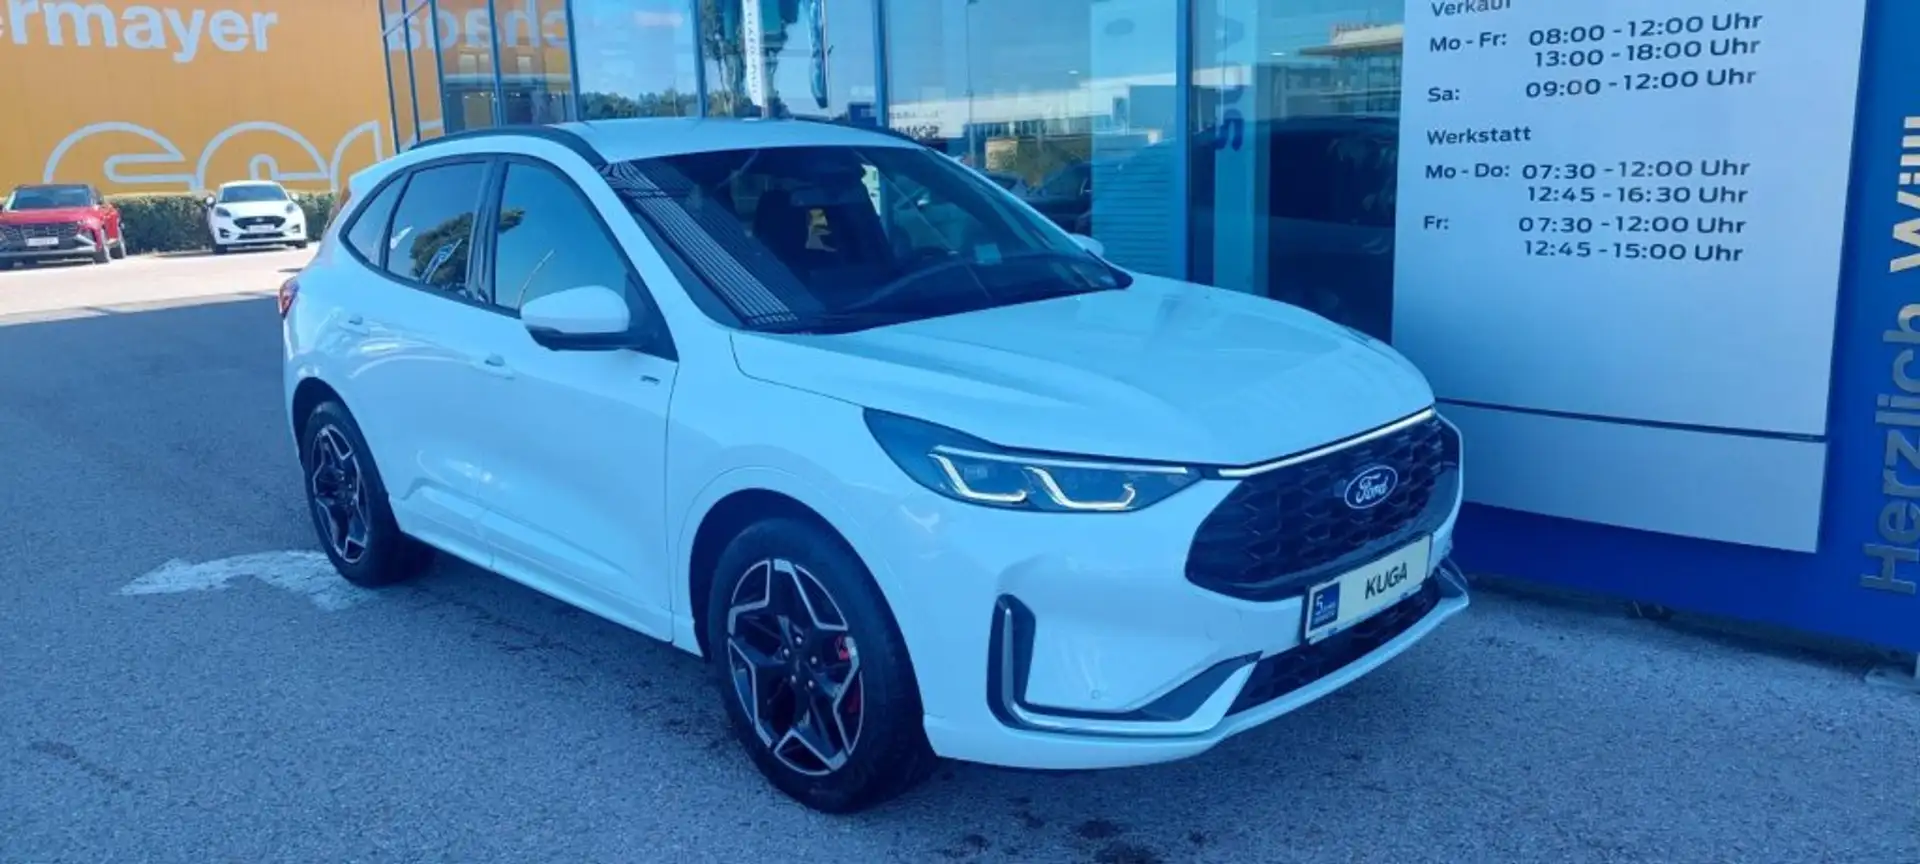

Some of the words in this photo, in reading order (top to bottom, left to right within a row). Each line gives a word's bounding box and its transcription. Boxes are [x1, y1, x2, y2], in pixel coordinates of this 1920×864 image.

[0, 0, 278, 63] rmayer
[1430, 36, 1461, 52] Mo
[1479, 31, 1507, 47] Fr:
[1529, 24, 1605, 46] 08:00
[1628, 16, 1704, 37] 12:00
[1712, 12, 1763, 31] Uhr
[1535, 49, 1604, 67] 13:00
[1626, 40, 1702, 61] 18:00
[1710, 37, 1762, 56] Uhr
[1428, 86, 1460, 102] Sa:
[1526, 78, 1601, 98] 09:00
[1624, 71, 1698, 90] 12:00
[1706, 68, 1757, 86] Uhr
[1427, 126, 1531, 145] Werkstatt
[1425, 164, 1456, 179] Mo
[1474, 162, 1510, 178] Do:
[1522, 163, 1596, 180] 07:30
[1618, 160, 1693, 177] 12:00
[1701, 159, 1751, 176] Uhr
[1528, 186, 1595, 202] 12:45
[1617, 186, 1691, 203] 16:30
[1699, 186, 1748, 203] Uhr
[1423, 215, 1449, 230] Fr:
[1518, 216, 1593, 234] 07:30
[1616, 215, 1689, 232] 12:00
[1697, 217, 1747, 233] Uhr
[1524, 240, 1591, 257] 12:45
[1613, 242, 1687, 260] 15:00
[1695, 244, 1743, 261] Uhr
[1860, 302, 1920, 595] Herzlich
[1365, 562, 1408, 599] KUGA
